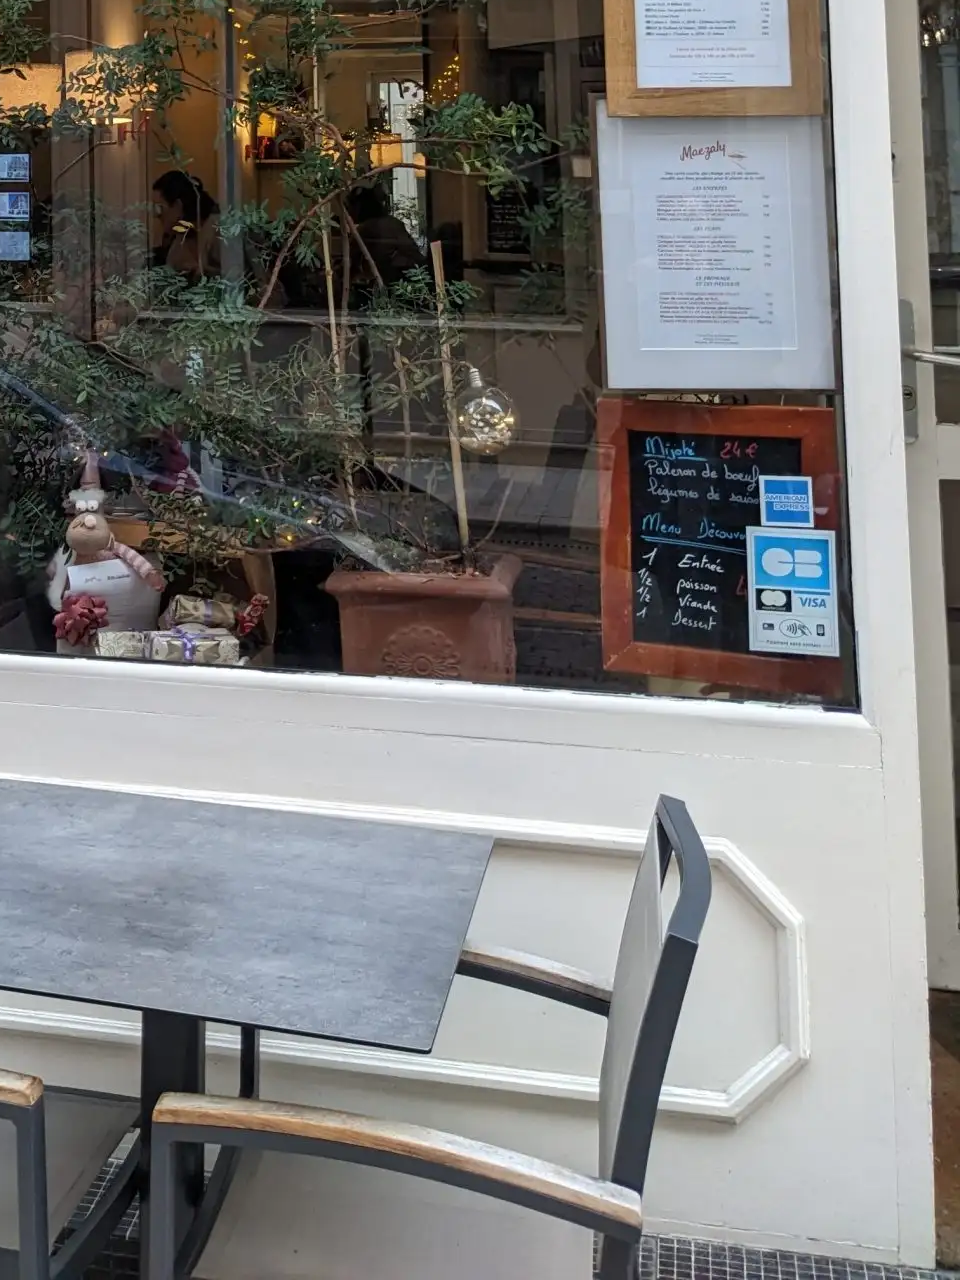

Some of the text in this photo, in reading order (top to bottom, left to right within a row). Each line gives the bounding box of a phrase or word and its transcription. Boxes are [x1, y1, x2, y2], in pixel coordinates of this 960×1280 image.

[680, 139, 725, 161] Maezaly
[645, 436, 695, 459] Mijoté
[644, 459, 696, 477] Paleron
[701, 462, 718, 478] de
[706, 485, 720, 501] de
[729, 493, 760, 504] saiso
[765, 494, 806, 502] AMERICAN
[774, 503, 809, 511] EXPRESS
[642, 513, 681, 534] Menu
[642, 547, 725, 573] 1 Entrée
[638, 567, 653, 586] 1/2
[636, 586, 718, 613] 1/2 Viande
[798, 597, 826, 608] VISA
[636, 606, 717, 631] 1 Dessert
